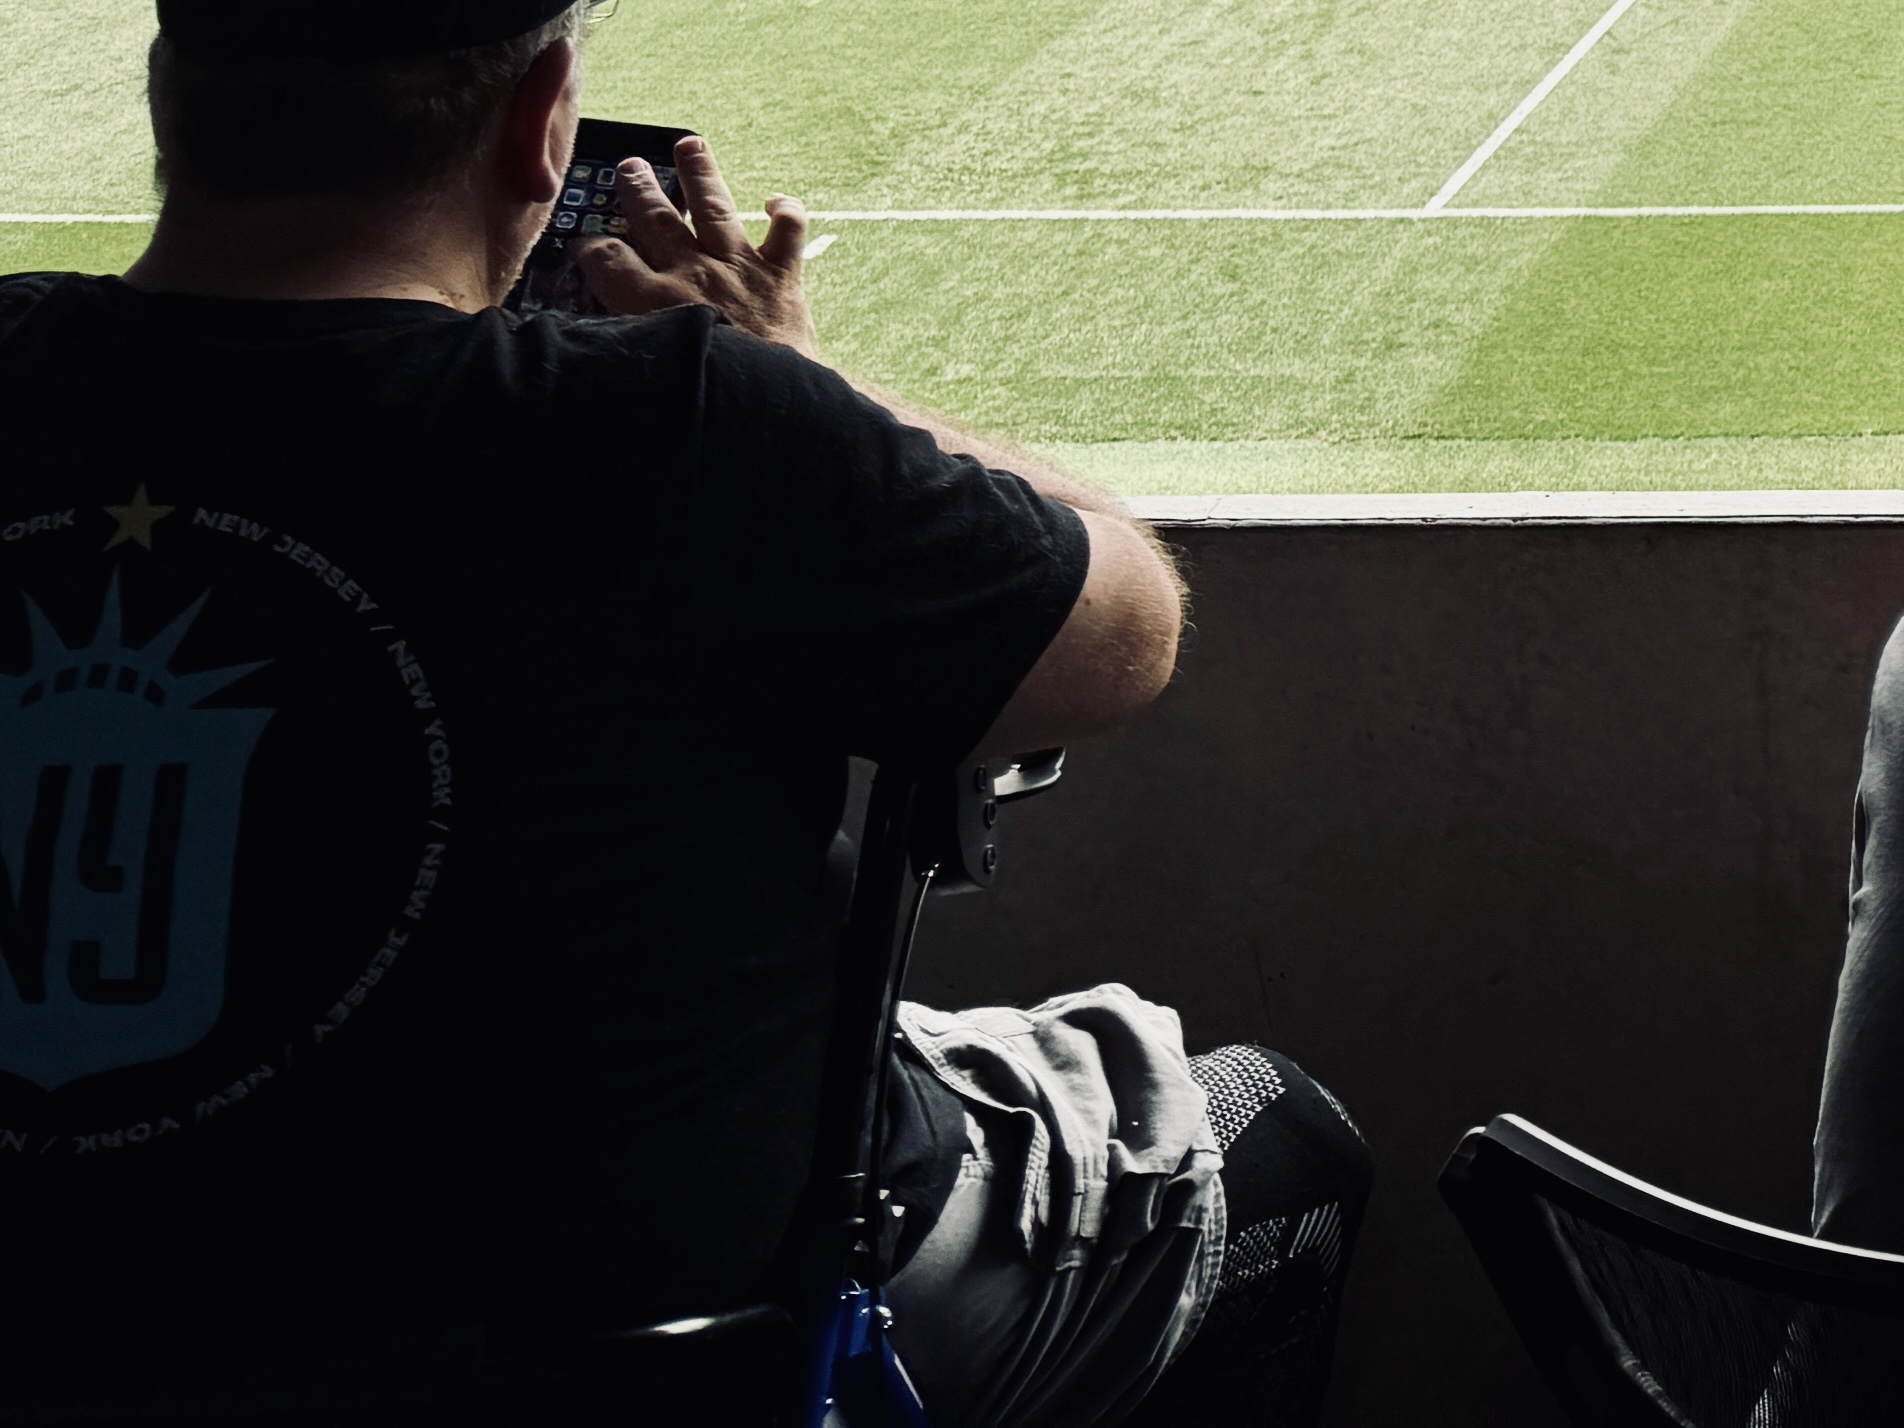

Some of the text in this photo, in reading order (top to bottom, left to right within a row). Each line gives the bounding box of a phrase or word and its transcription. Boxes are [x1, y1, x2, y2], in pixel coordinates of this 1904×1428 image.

[190, 506, 272, 543] NEW
[272, 534, 380, 616] JERSEY
[386, 638, 437, 713] NEW
[423, 716, 454, 810] YORK
[403, 842, 447, 921] NEW
[312, 927, 409, 1044] JERSEY
